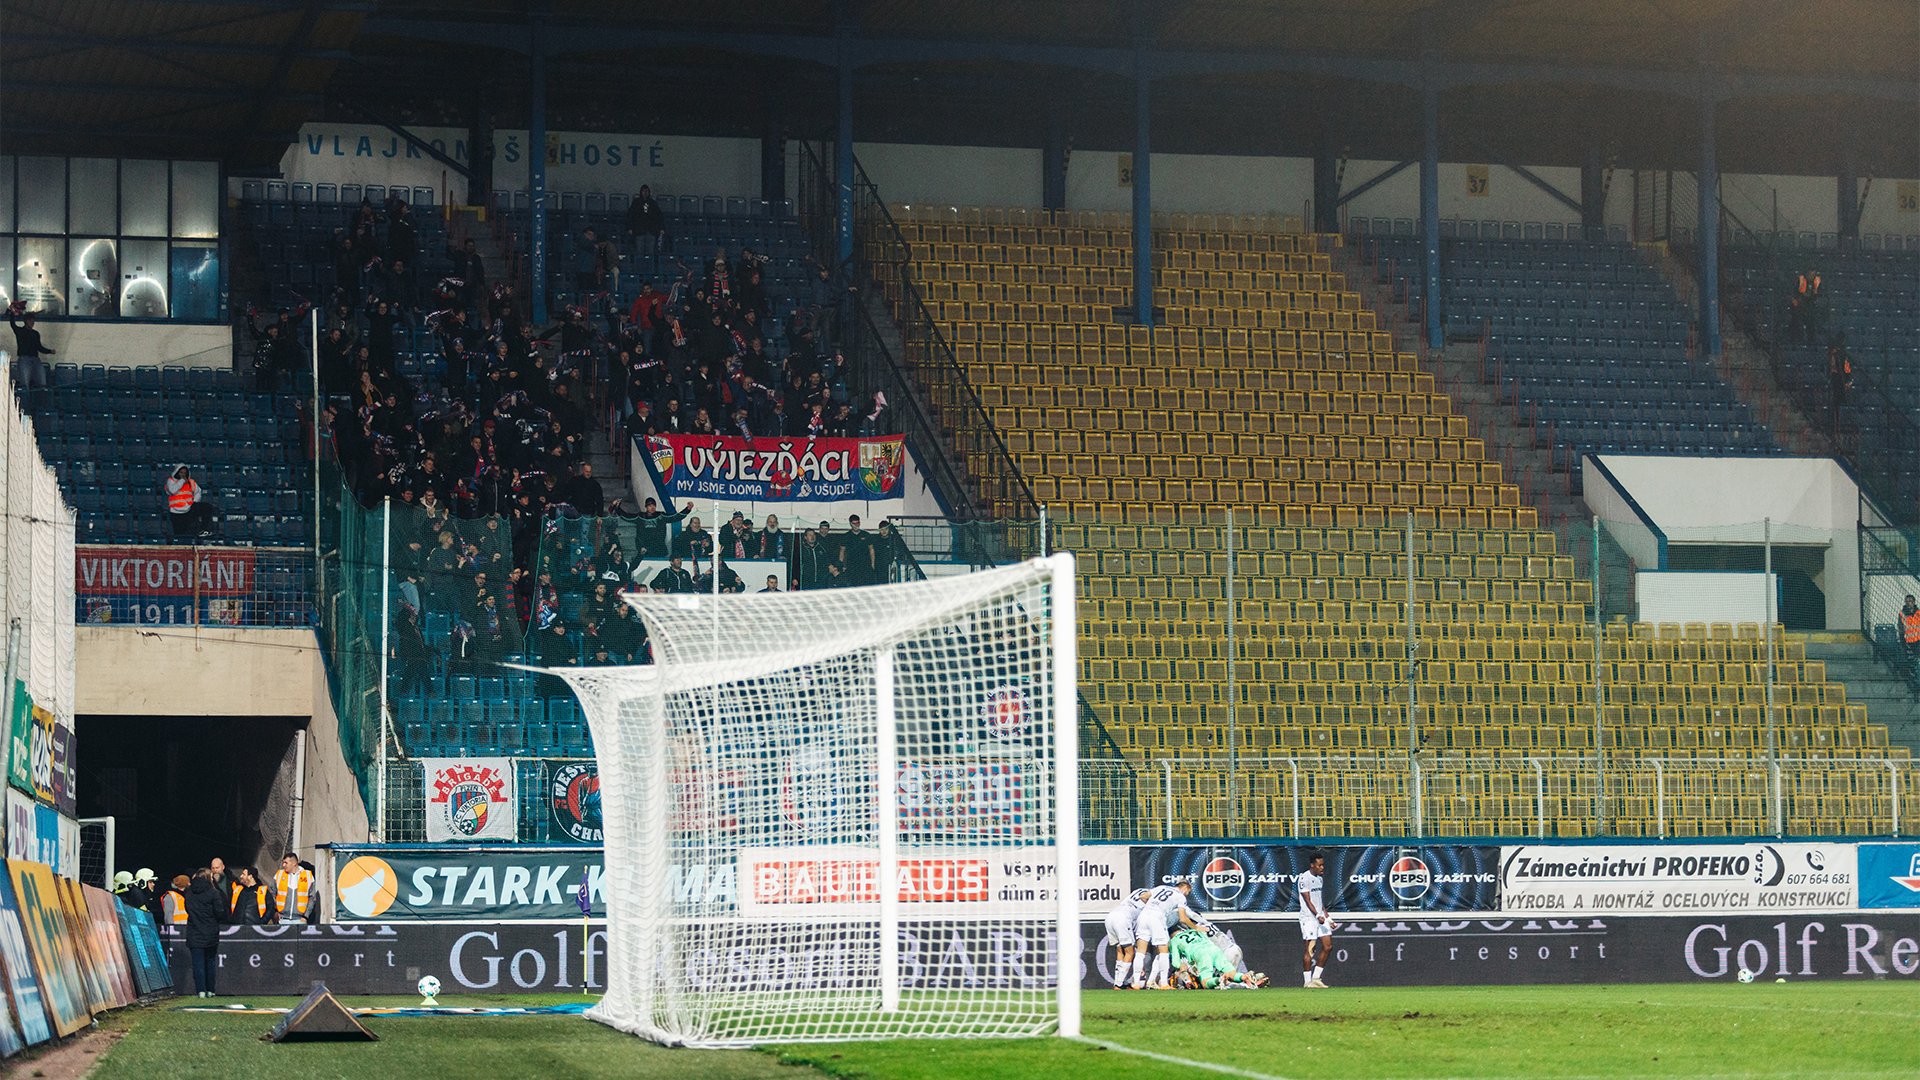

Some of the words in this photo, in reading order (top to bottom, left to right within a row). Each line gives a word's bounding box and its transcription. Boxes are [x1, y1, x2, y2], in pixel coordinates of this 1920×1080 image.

[306, 133, 521, 164] VLAJKONŠ
[560, 141, 665, 168] HOSTÉ
[1470, 175, 1487, 193] 37
[683, 441, 850, 482] VÝJEZĎÁCI
[677, 480, 694, 492] MY
[698, 481, 726, 495] JSME
[729, 484, 763, 496] DOMA
[814, 482, 855, 496] VŠUDE!
[80, 554, 246, 589] VIKTORIÁNI
[129, 603, 193, 625] 1911
[441, 772, 498, 794] BRIGADE
[555, 764, 586, 797] WEST
[459, 796, 487, 813] VIKTORIA
[1003, 860, 1032, 877] Vše
[1036, 863, 1059, 881] pr
[1078, 860, 1115, 881] ílnu,
[1515, 856, 1647, 878] Zámečnictví
[1652, 855, 1750, 877] PROFEKO
[1754, 849, 1764, 885] s.r.o.
[408, 865, 737, 906] STARK-KMA
[758, 866, 985, 897] BAUHAUS
[1205, 874, 1242, 884] PEPSI
[1248, 872, 1288, 884] ZAŽÍT
[1350, 872, 1386, 884] CHUŤ
[1392, 873, 1428, 883] PEPSI
[1433, 872, 1472, 884] ZAŽÍT
[1473, 872, 1496, 884] VÍC
[1787, 873, 1806, 885] 607
[1809, 873, 1829, 885] 664
[1832, 873, 1851, 884] 681
[997, 883, 1035, 901] dům
[1039, 889, 1050, 901] a
[1153, 888, 1174, 902] 18
[1506, 890, 1566, 910] VÝROBA
[1573, 894, 1584, 909] A
[1592, 890, 1656, 909] MONTÁŽ
[1662, 889, 1750, 908] OCELOVÝCH
[1757, 888, 1852, 907] KONSTRUKCÍ
[217, 949, 397, 968] resort
[449, 930, 608, 990] Golf
[1449, 941, 1608, 961] resort
[1684, 921, 1825, 978] Golf
